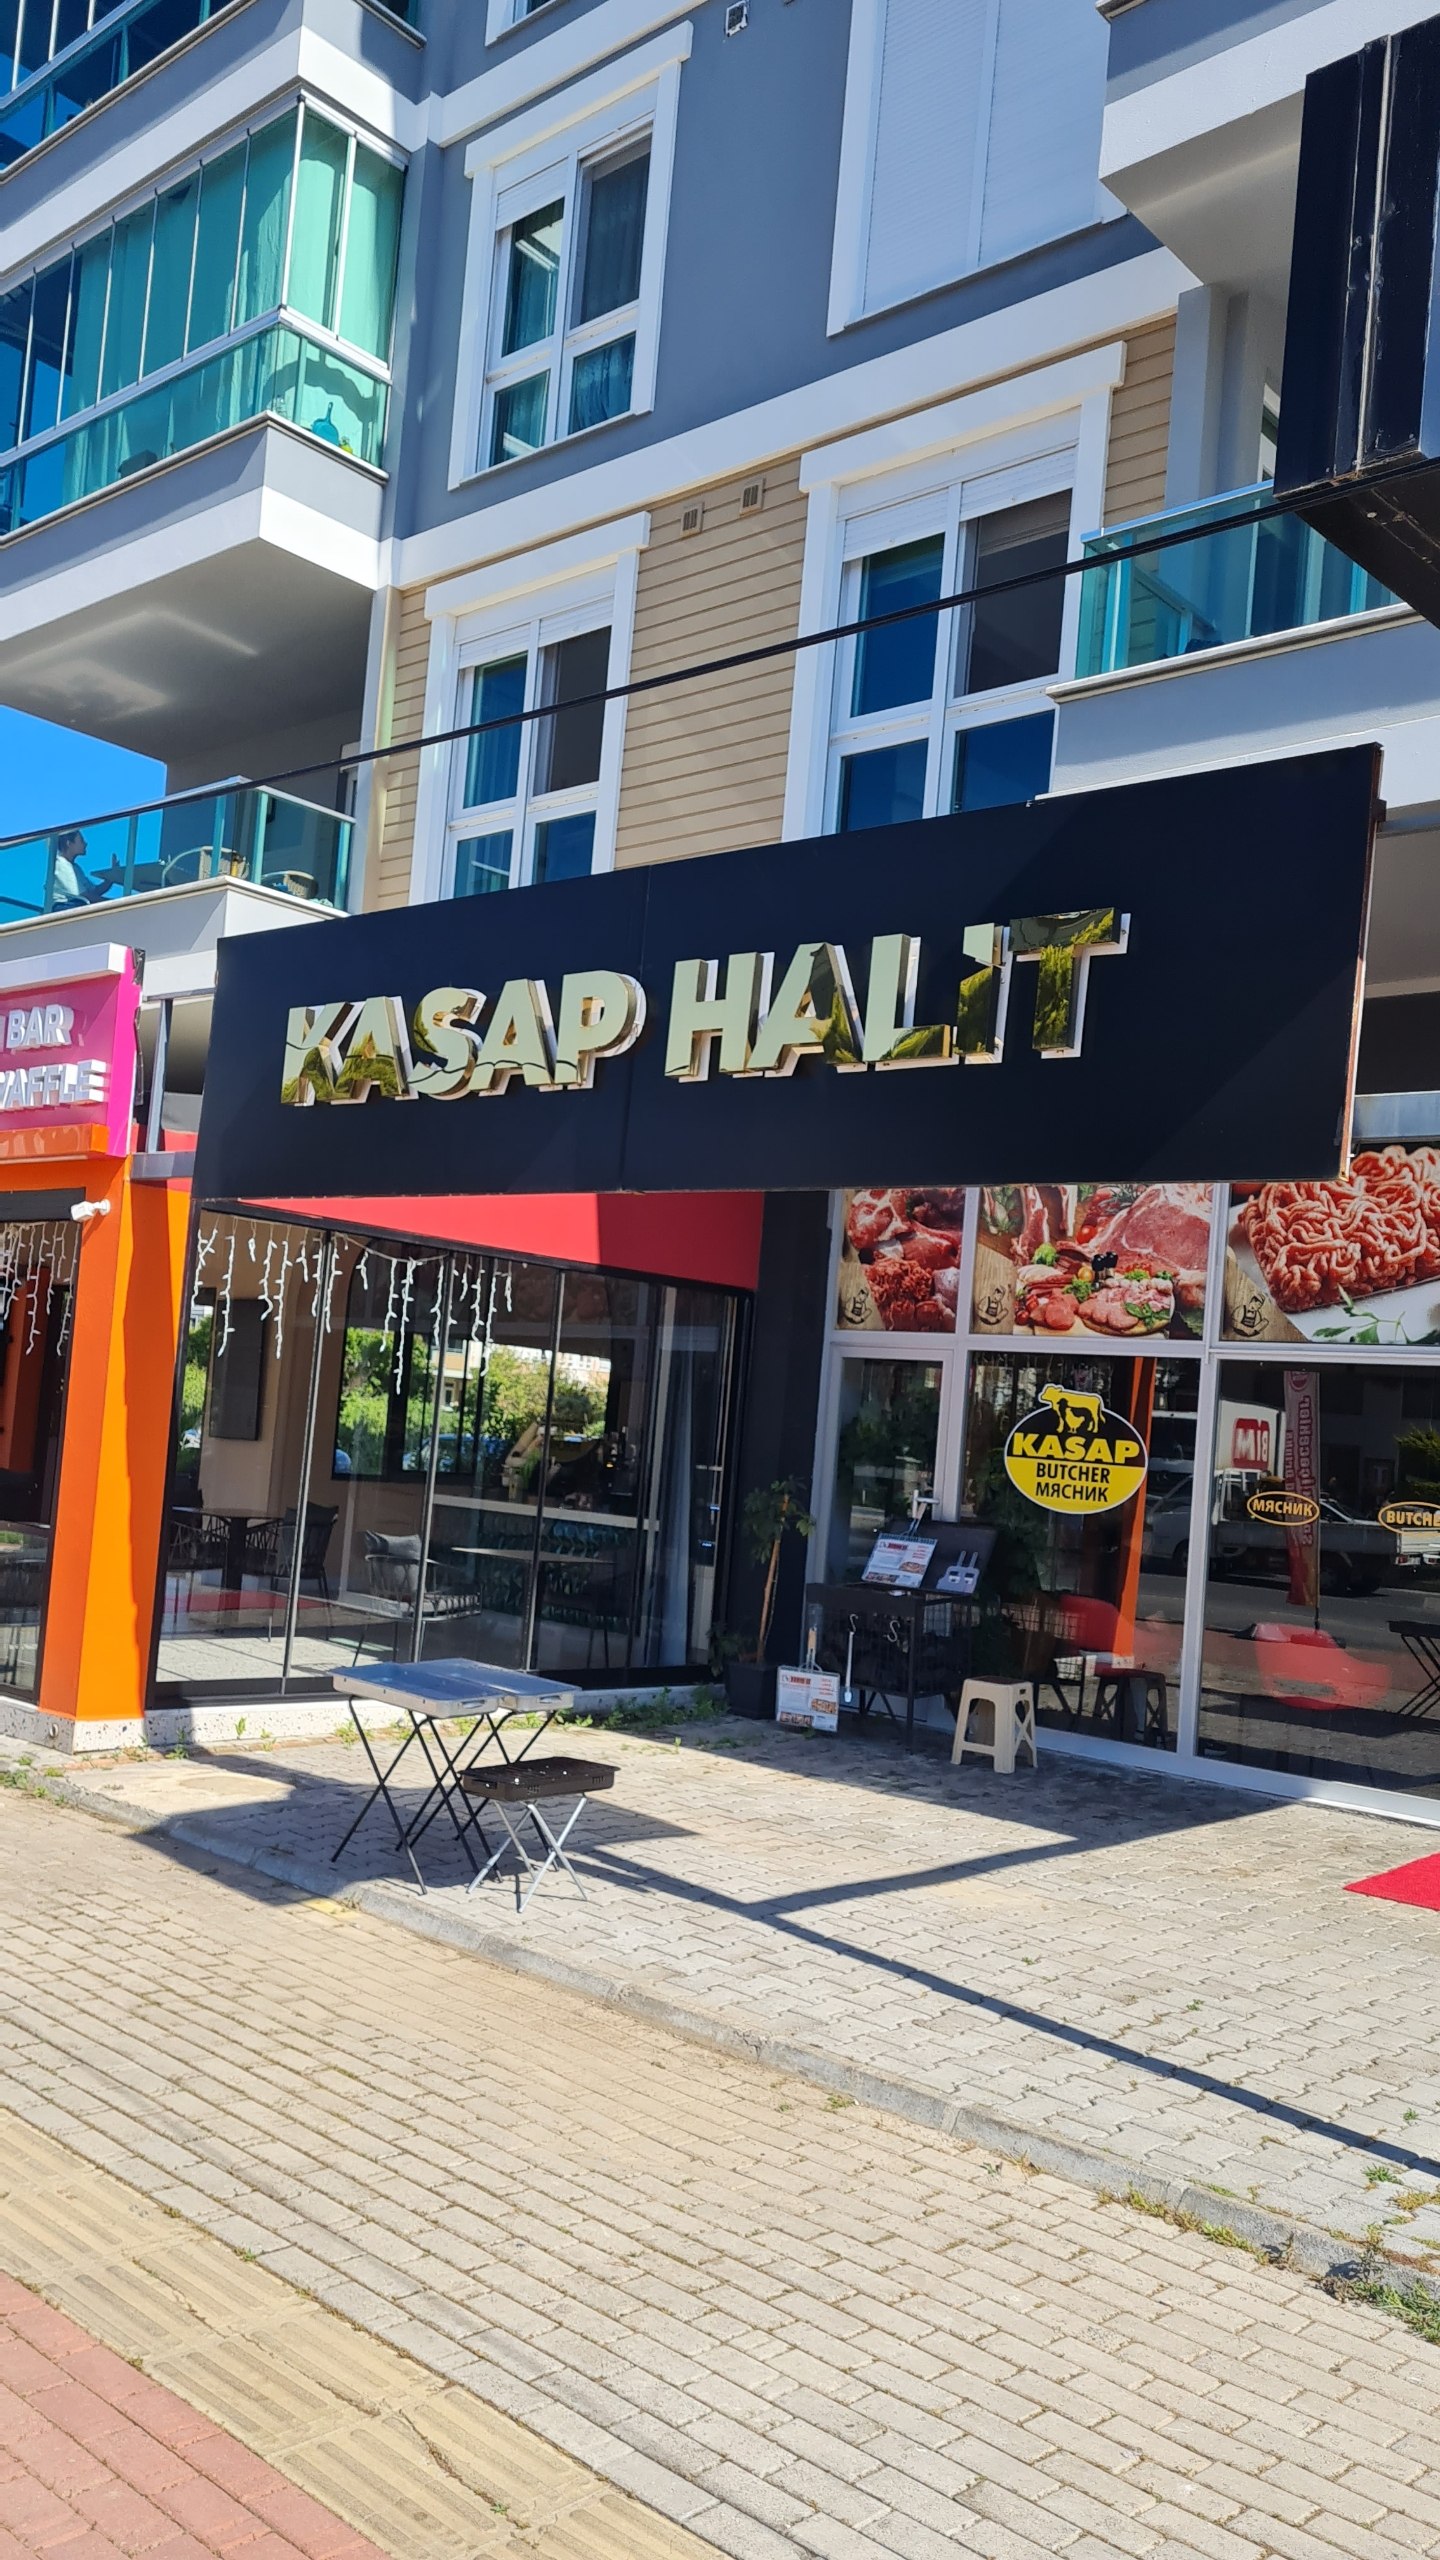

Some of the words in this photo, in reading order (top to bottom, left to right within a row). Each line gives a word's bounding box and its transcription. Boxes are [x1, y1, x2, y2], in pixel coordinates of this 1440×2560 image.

[6, 1004, 74, 1050] BAR
[281, 970, 647, 1106] KASAP
[1012, 1432, 1140, 1464] KASAP
[1036, 1462, 1110, 1484] BUTCHER
[1035, 1482, 1109, 1503] МЯСНИК
[1253, 1499, 1314, 1517] МЯСНИК
